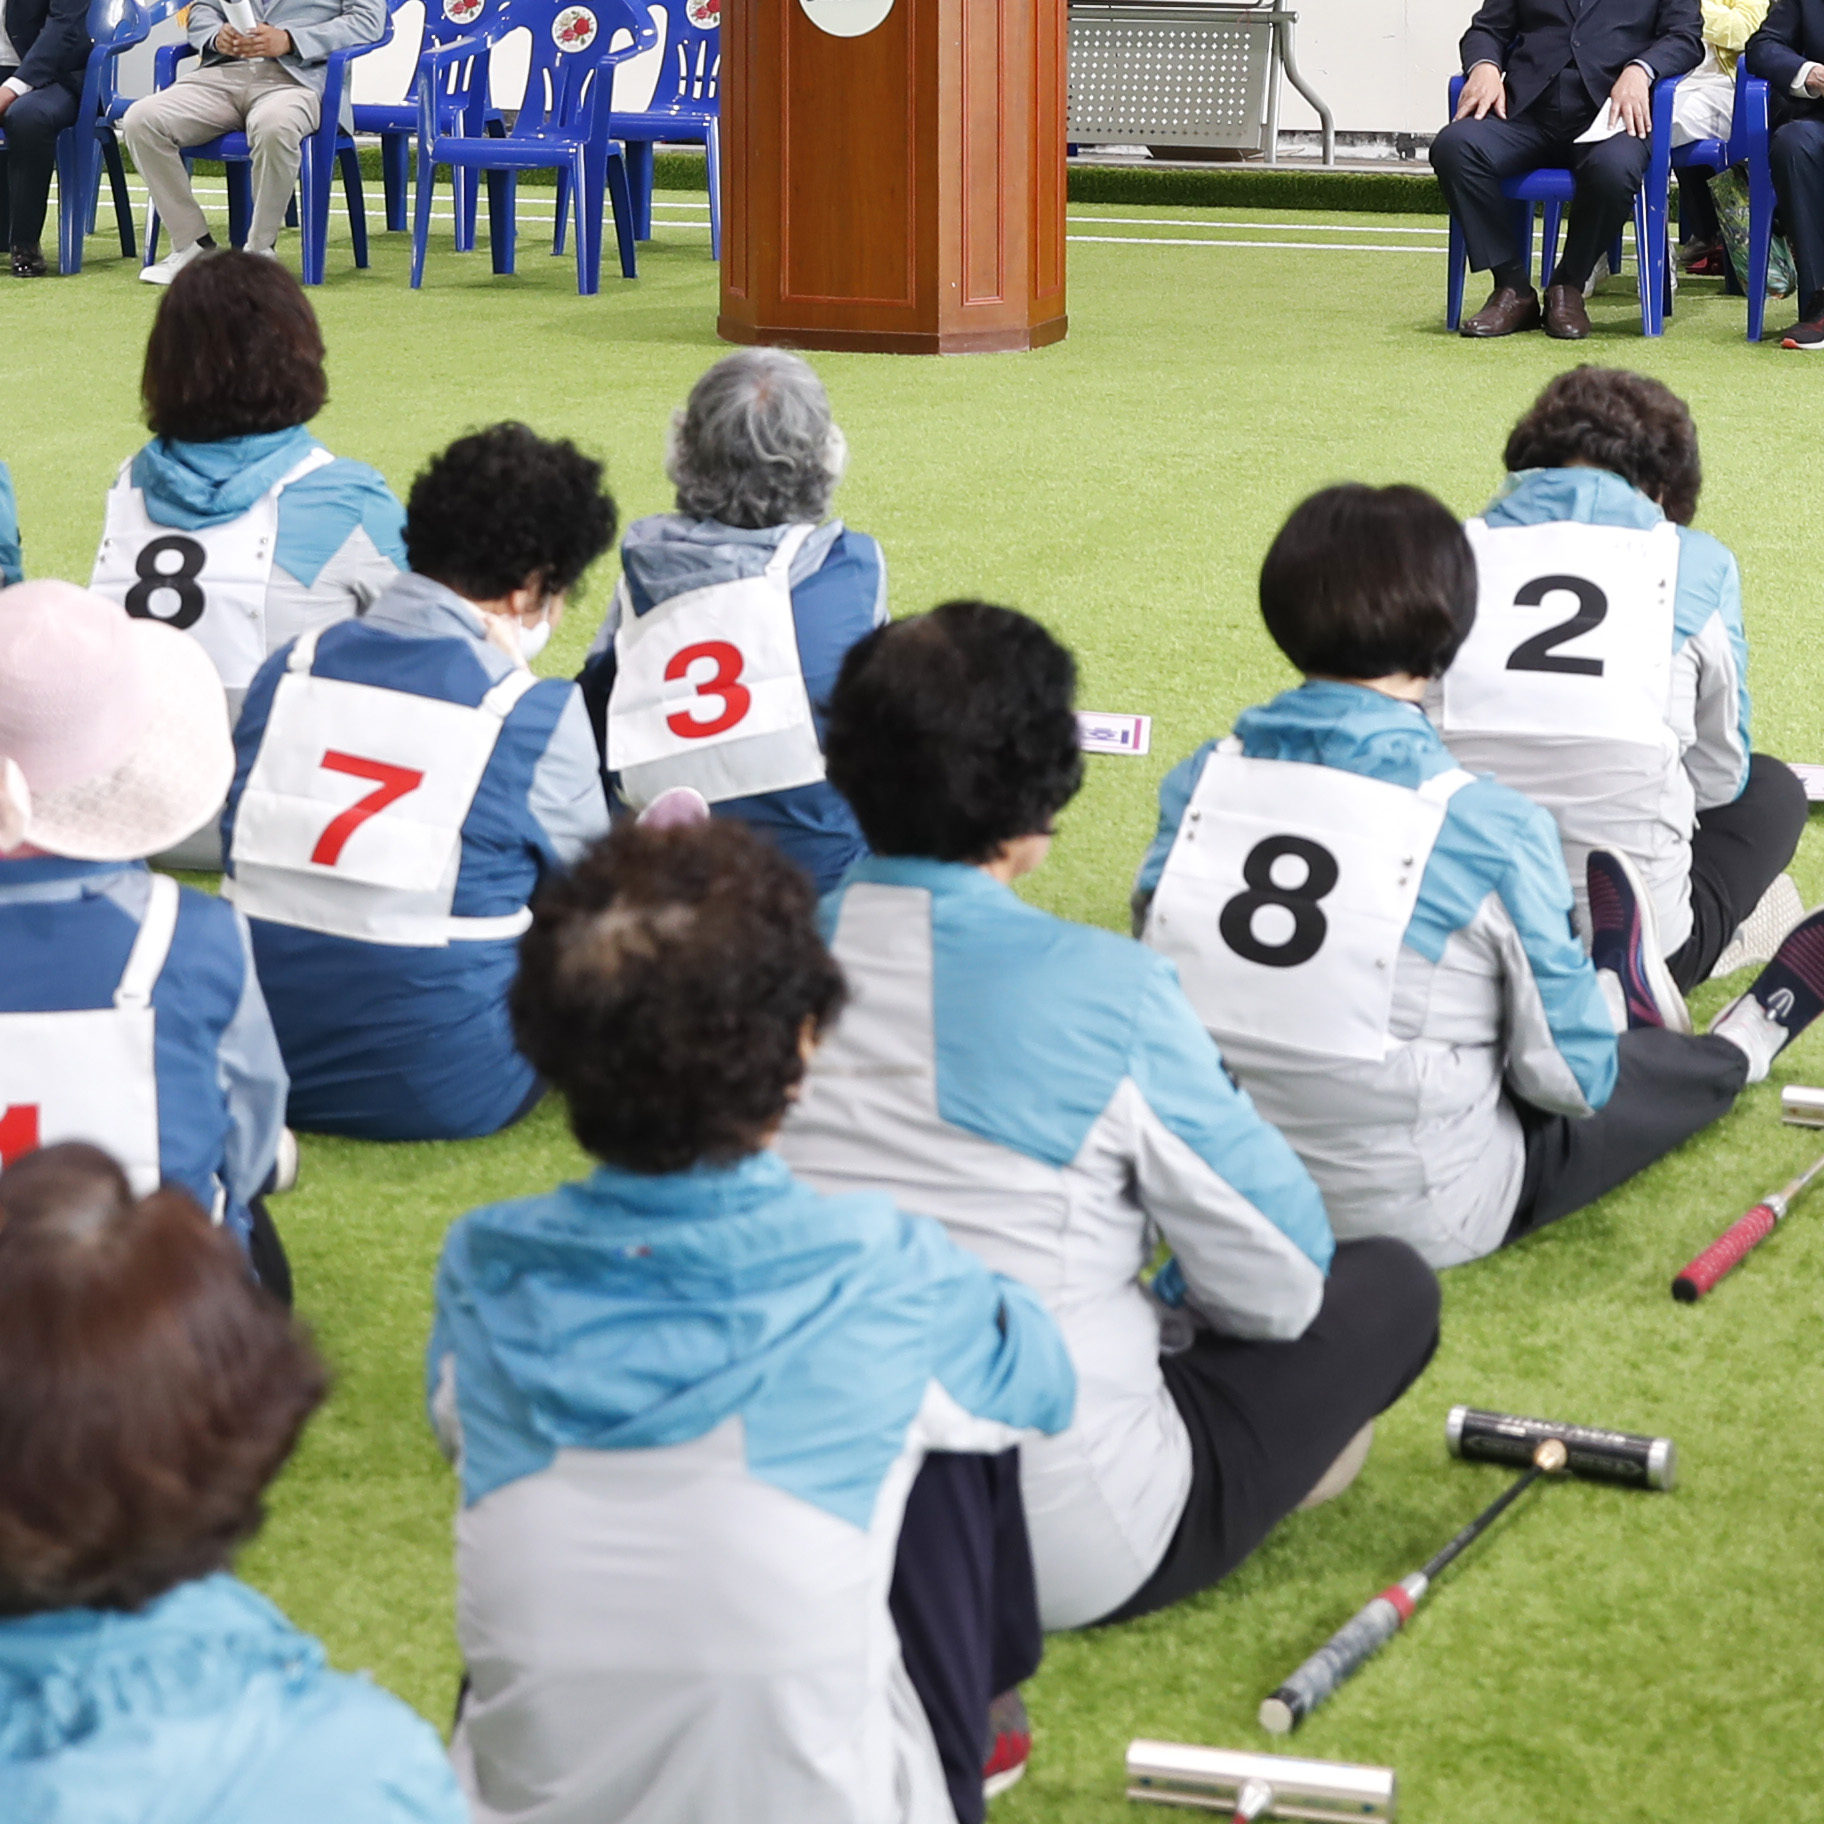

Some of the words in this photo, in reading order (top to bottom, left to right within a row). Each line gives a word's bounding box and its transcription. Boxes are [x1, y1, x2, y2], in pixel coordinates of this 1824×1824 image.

[119, 531, 211, 635] 8
[1506, 575, 1607, 676] 2
[664, 641, 750, 738] 3
[310, 750, 423, 866] 7
[1213, 830, 1343, 972] 8
